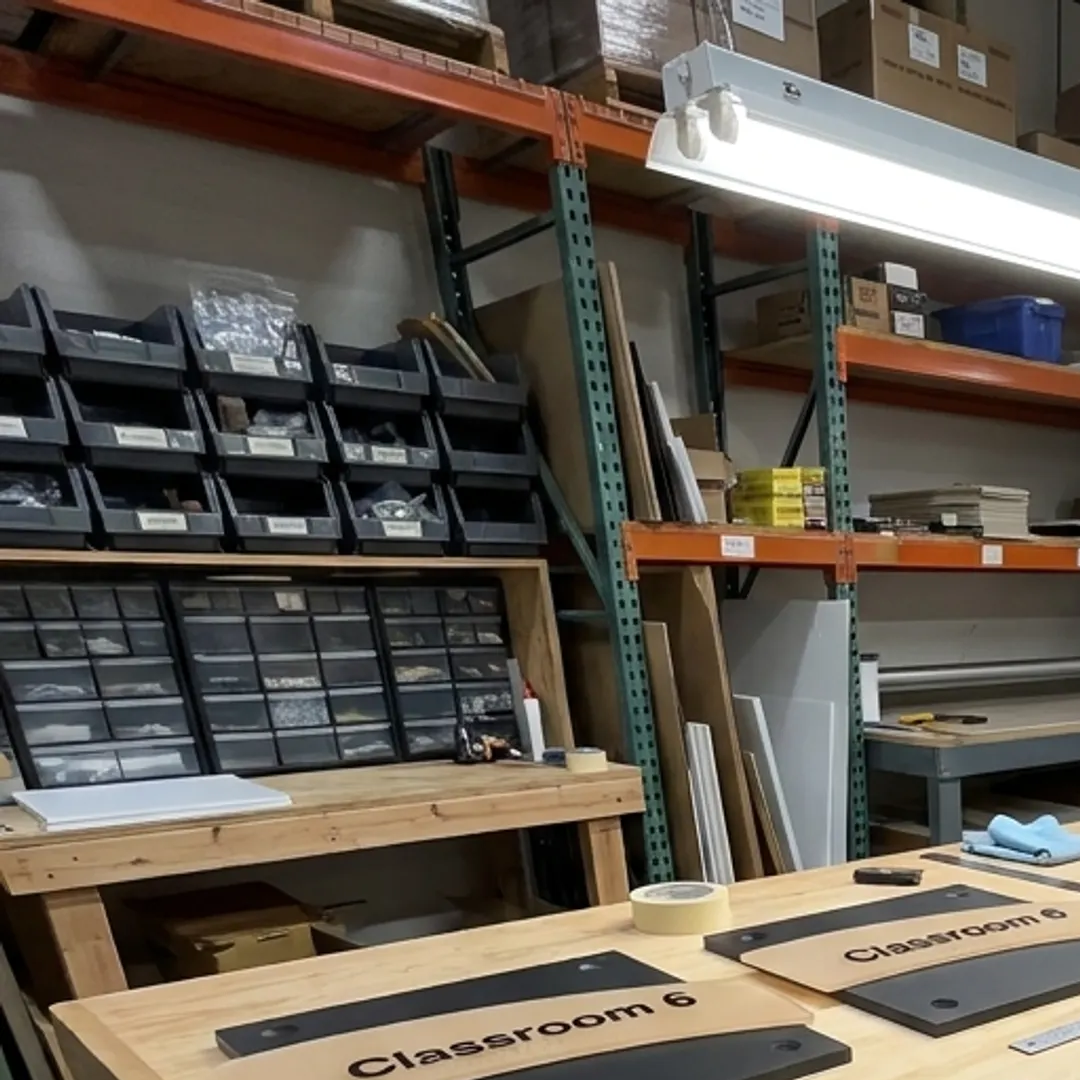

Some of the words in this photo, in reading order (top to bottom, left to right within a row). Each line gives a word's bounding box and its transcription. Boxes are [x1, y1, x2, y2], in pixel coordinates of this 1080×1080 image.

[844, 914, 1041, 963] Classroom
[347, 1003, 656, 1079] Classroom
[662, 991, 697, 1008] 6
